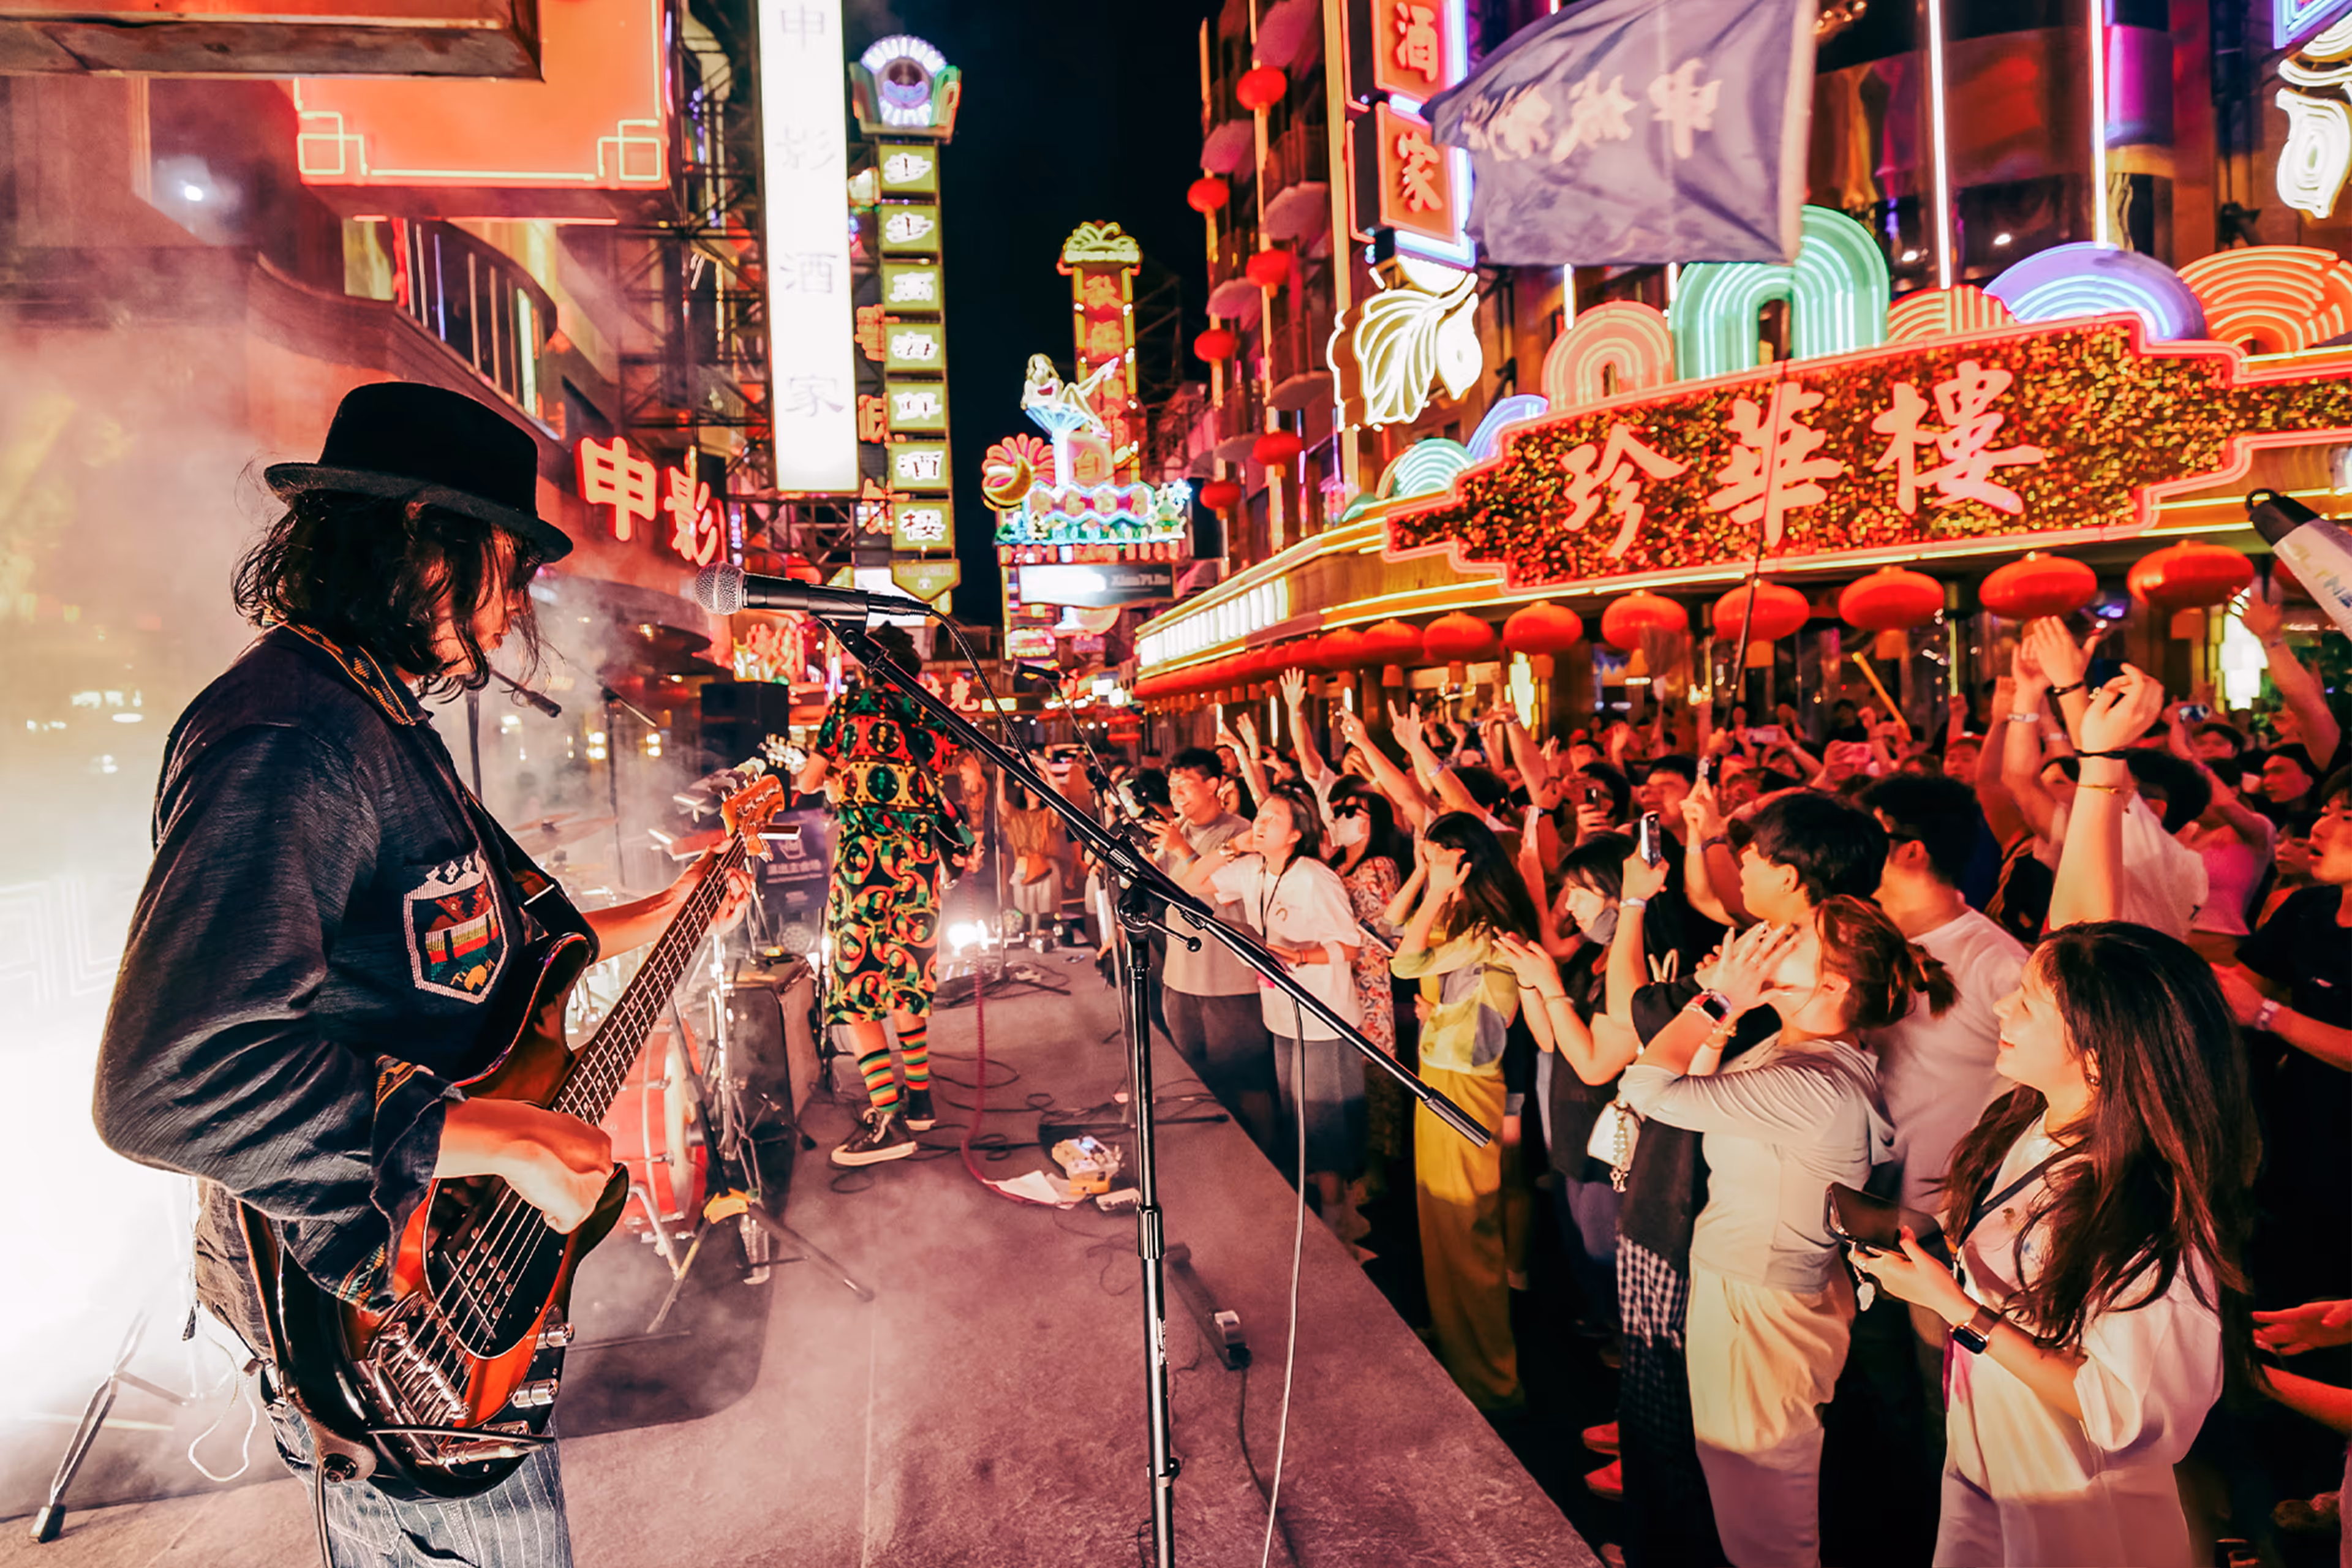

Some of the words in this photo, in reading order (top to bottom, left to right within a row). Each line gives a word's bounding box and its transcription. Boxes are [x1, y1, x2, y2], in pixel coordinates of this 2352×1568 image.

[1396, 2, 1442, 213] 酒家
[775, 4, 845, 417] 申影酒家
[578, 435, 718, 567] 申影
[1559, 359, 2045, 559] 珍華樓
